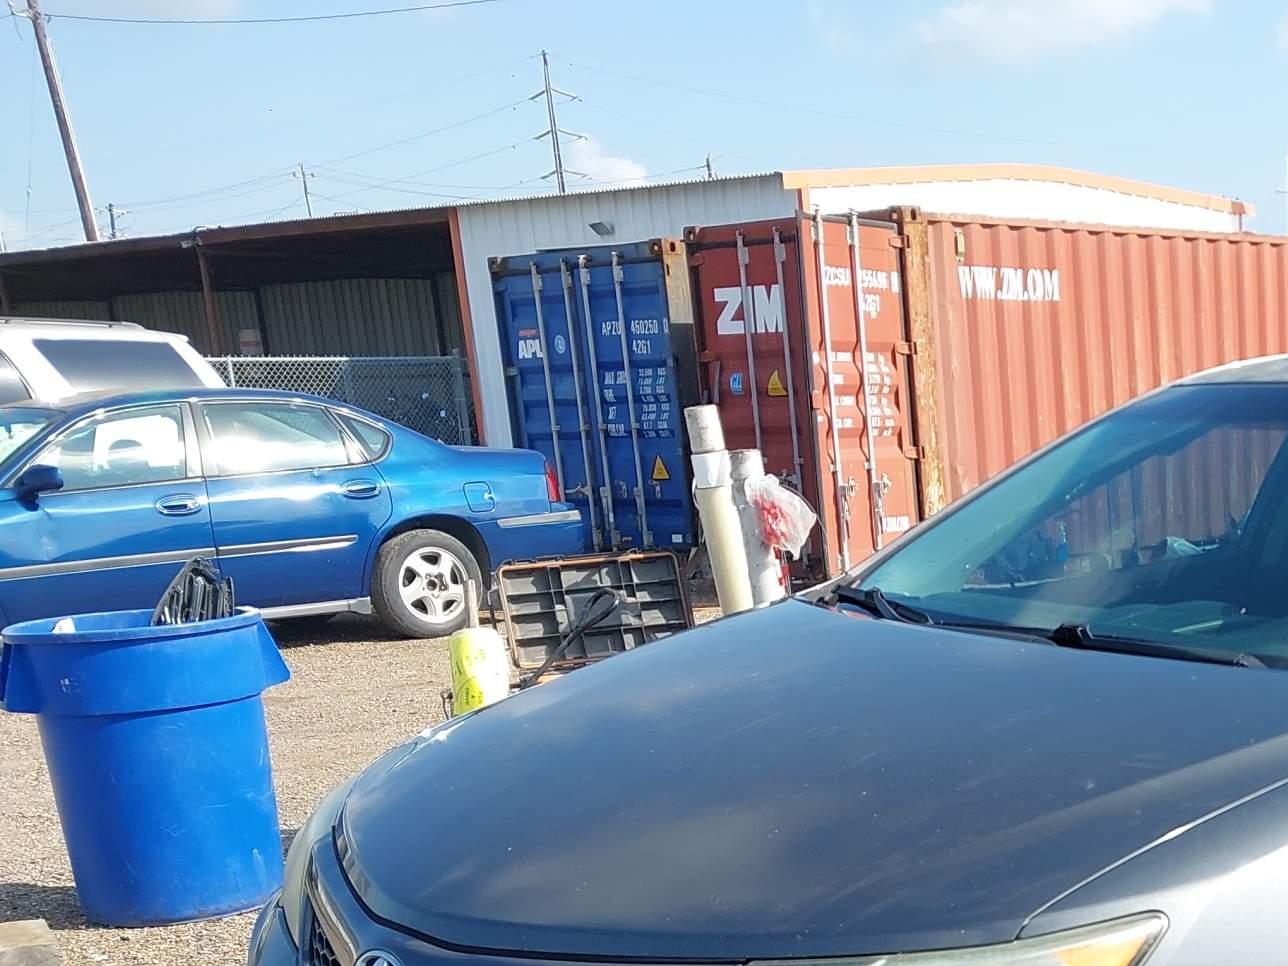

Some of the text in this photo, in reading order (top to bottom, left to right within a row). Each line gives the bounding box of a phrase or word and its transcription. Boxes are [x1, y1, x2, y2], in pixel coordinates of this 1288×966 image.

[714, 284, 784, 335] ZIM
[601, 321, 621, 336] APZU
[518, 338, 544, 359] APL
[632, 339, 651, 354] 42G1
